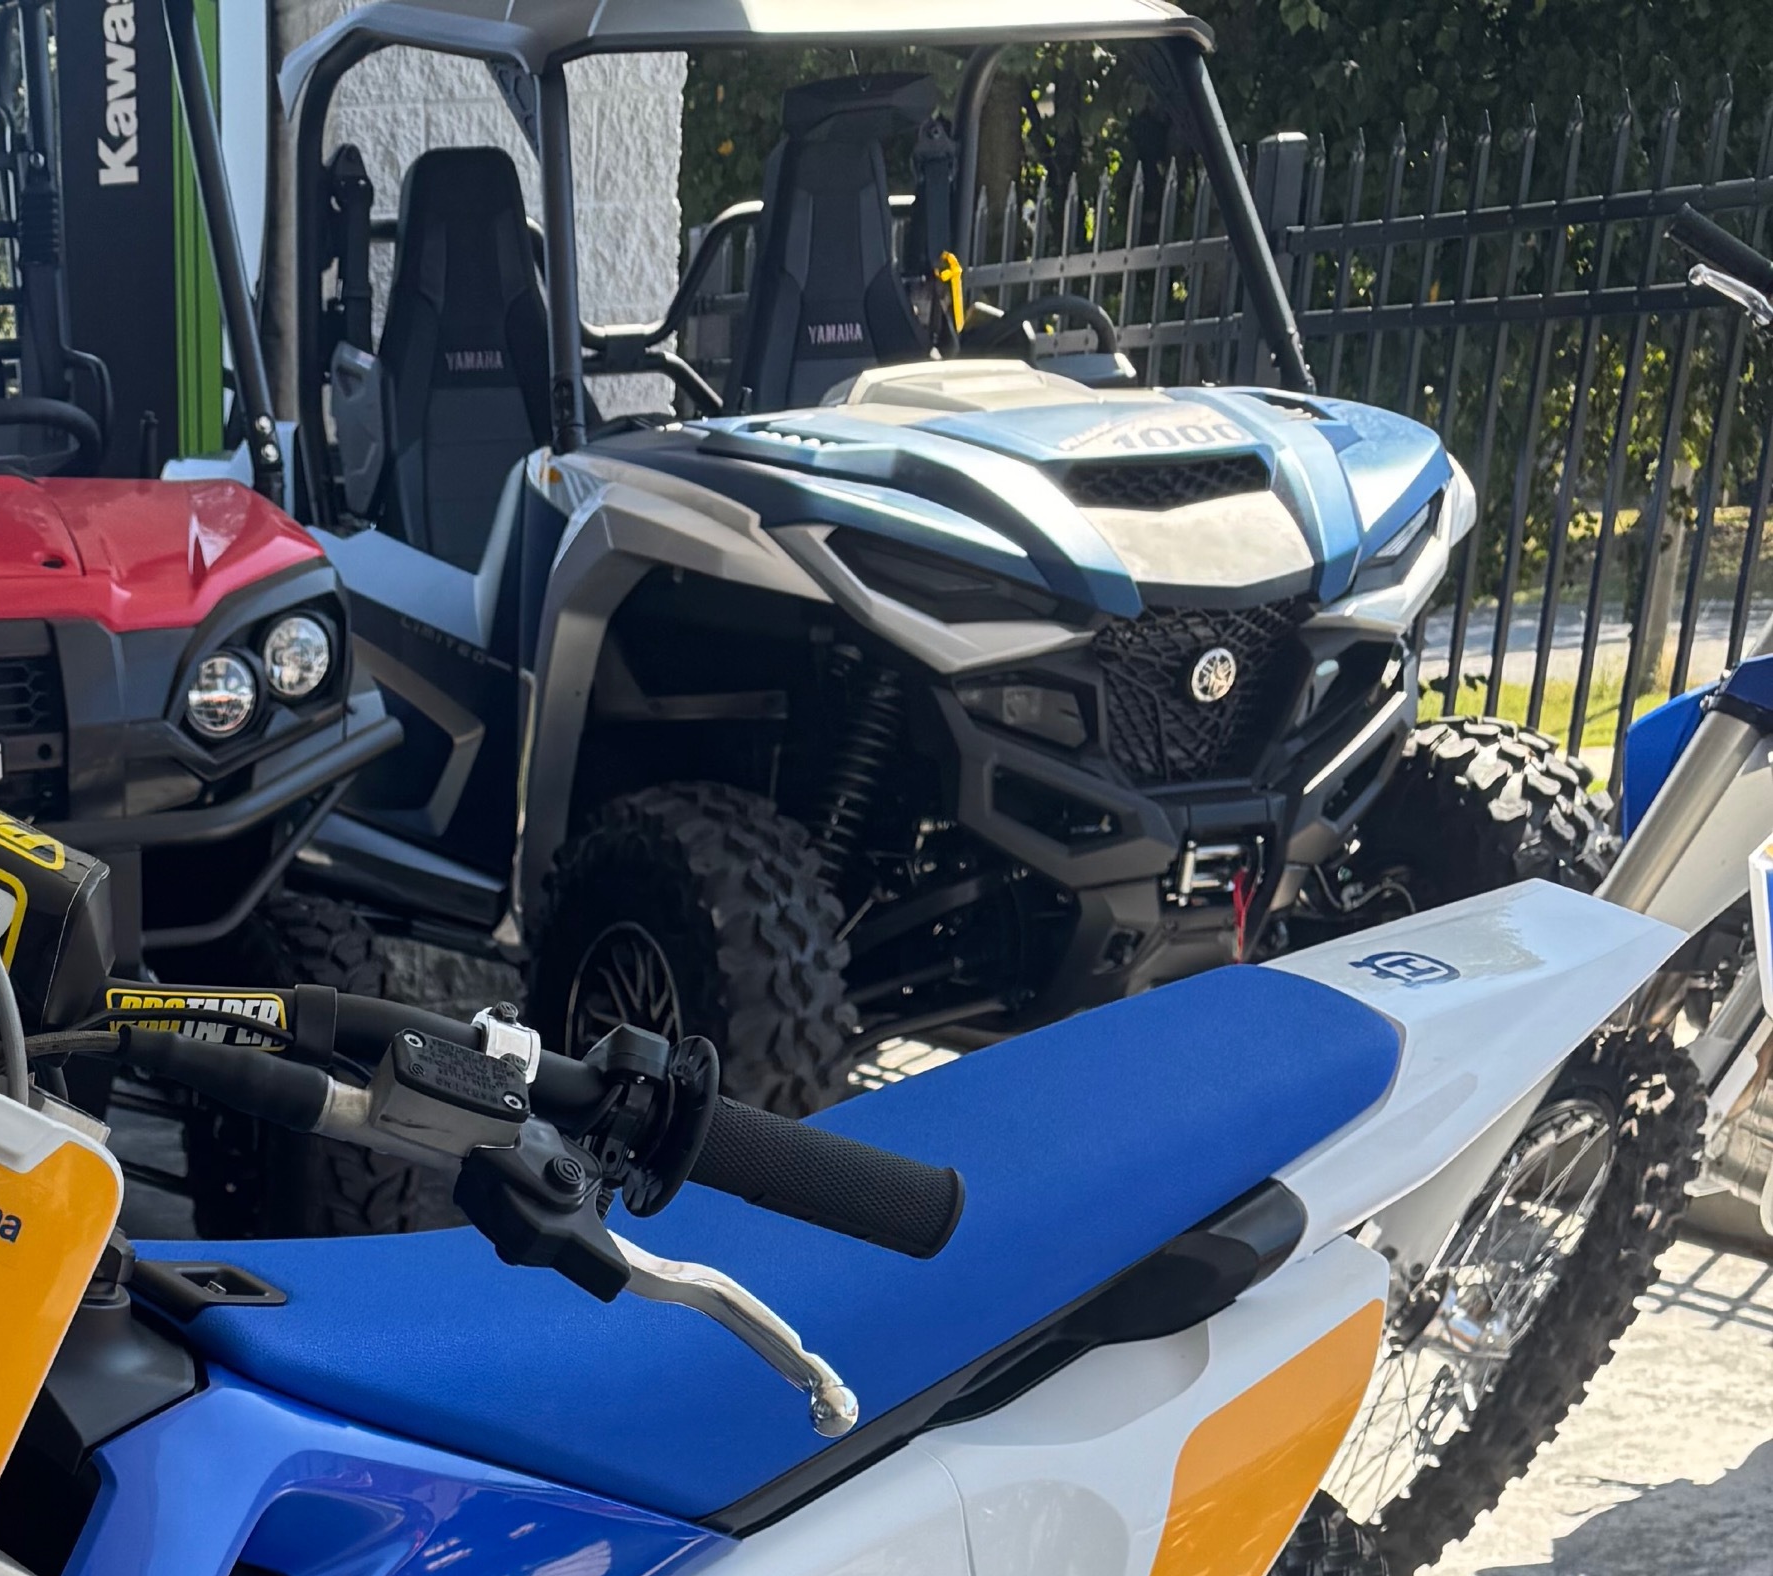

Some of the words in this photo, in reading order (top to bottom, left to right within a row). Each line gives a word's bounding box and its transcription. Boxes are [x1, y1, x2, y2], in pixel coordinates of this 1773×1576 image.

[97, 0, 139, 186] Kawa
[808, 322, 863, 345] YAMAHA
[445, 350, 504, 371] YAMAHA
[1112, 423, 1246, 450] 1000
